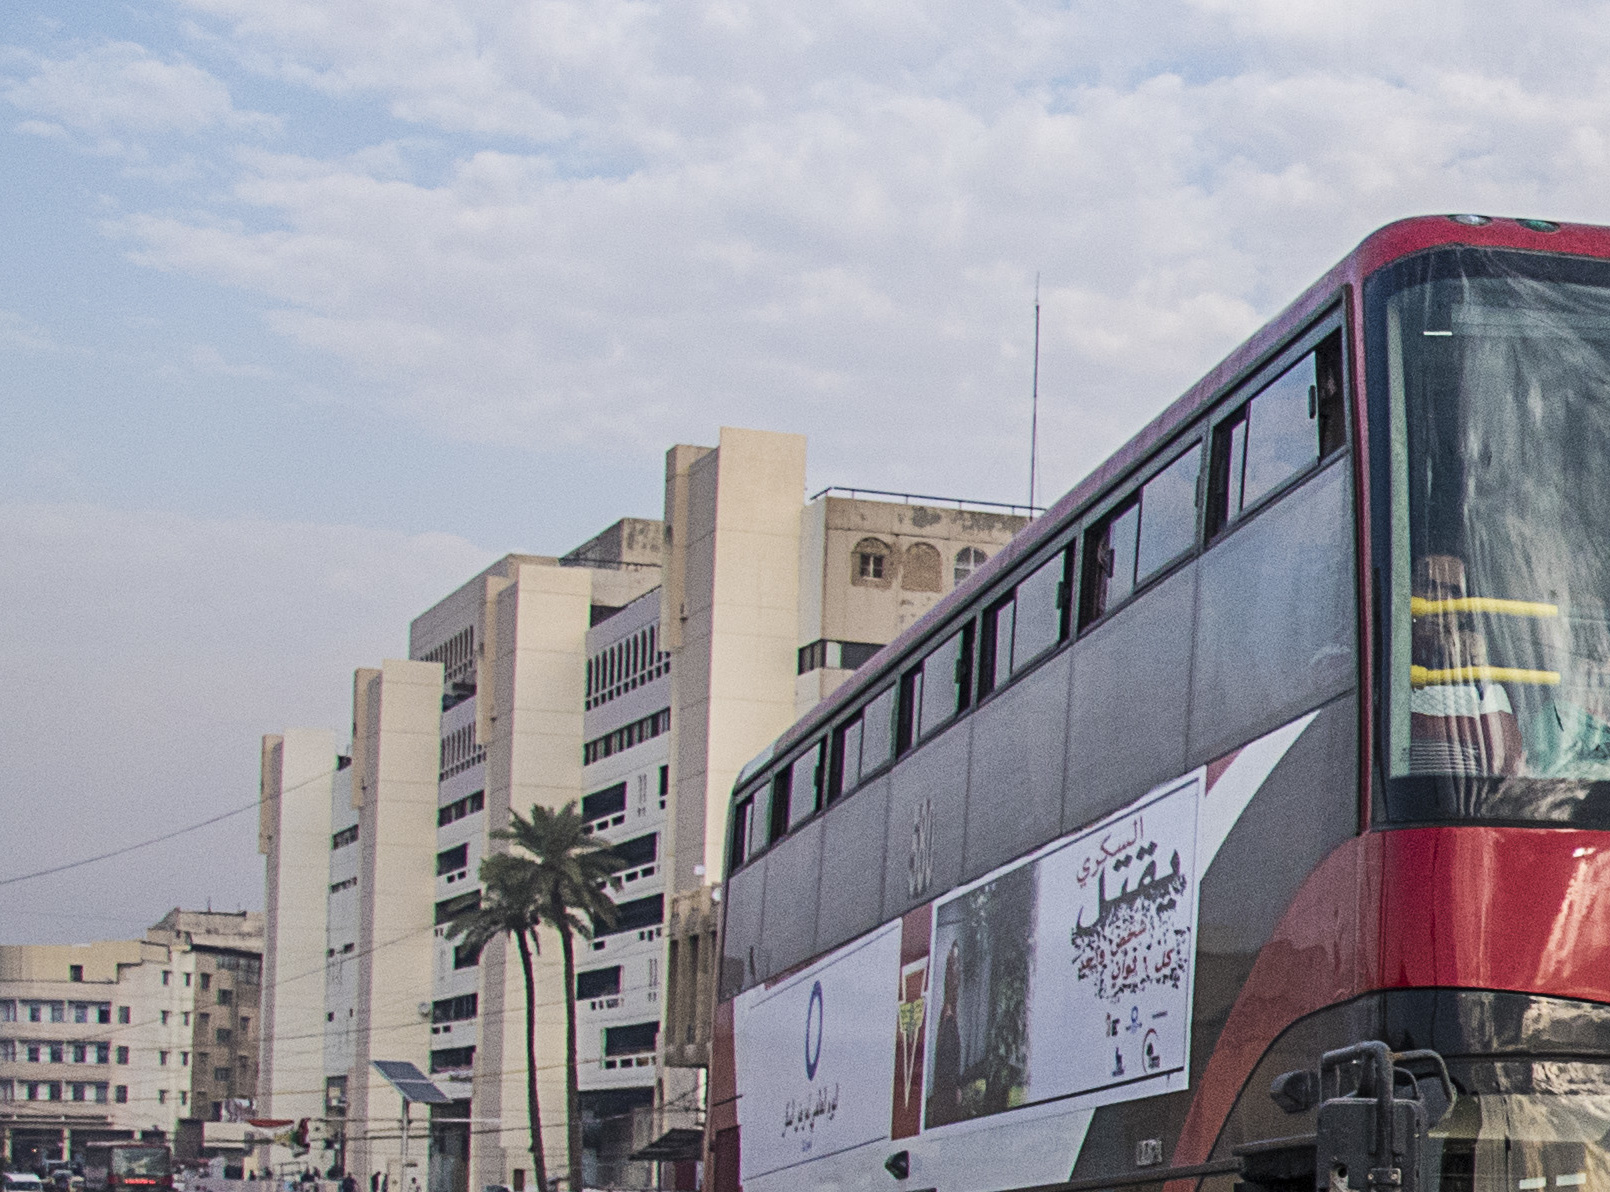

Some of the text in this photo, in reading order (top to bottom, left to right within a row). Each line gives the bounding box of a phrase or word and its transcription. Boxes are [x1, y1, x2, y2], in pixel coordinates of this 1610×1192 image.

[1076, 815, 1144, 888] السكري
[1072, 842, 1181, 937] يقتل
[1154, 947, 1175, 973] كل
